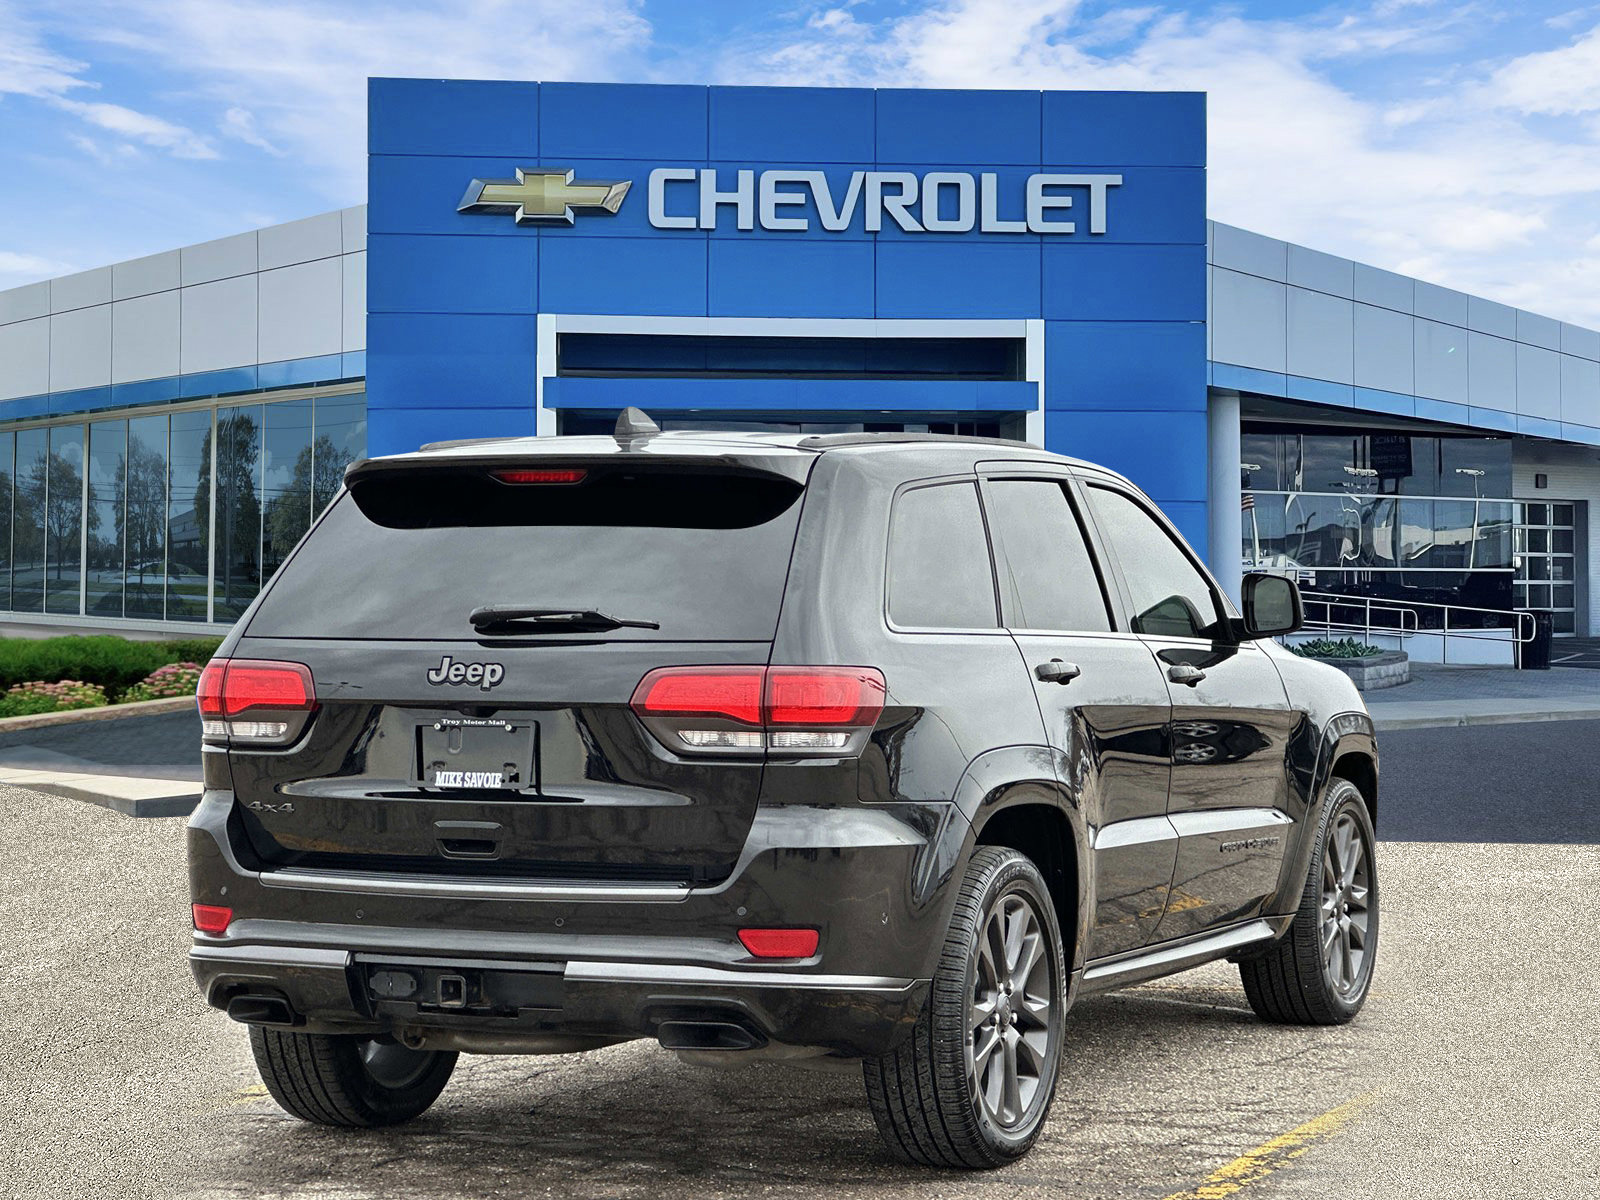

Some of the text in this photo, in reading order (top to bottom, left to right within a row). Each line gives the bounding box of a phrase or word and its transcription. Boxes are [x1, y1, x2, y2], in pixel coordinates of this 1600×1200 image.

[648, 168, 1123, 234] CHEVROLET
[427, 656, 505, 691] Jeep
[441, 718, 461, 726] Troy
[434, 771, 503, 788] MIKE SAVOIE
[247, 801, 295, 813] 4x4
